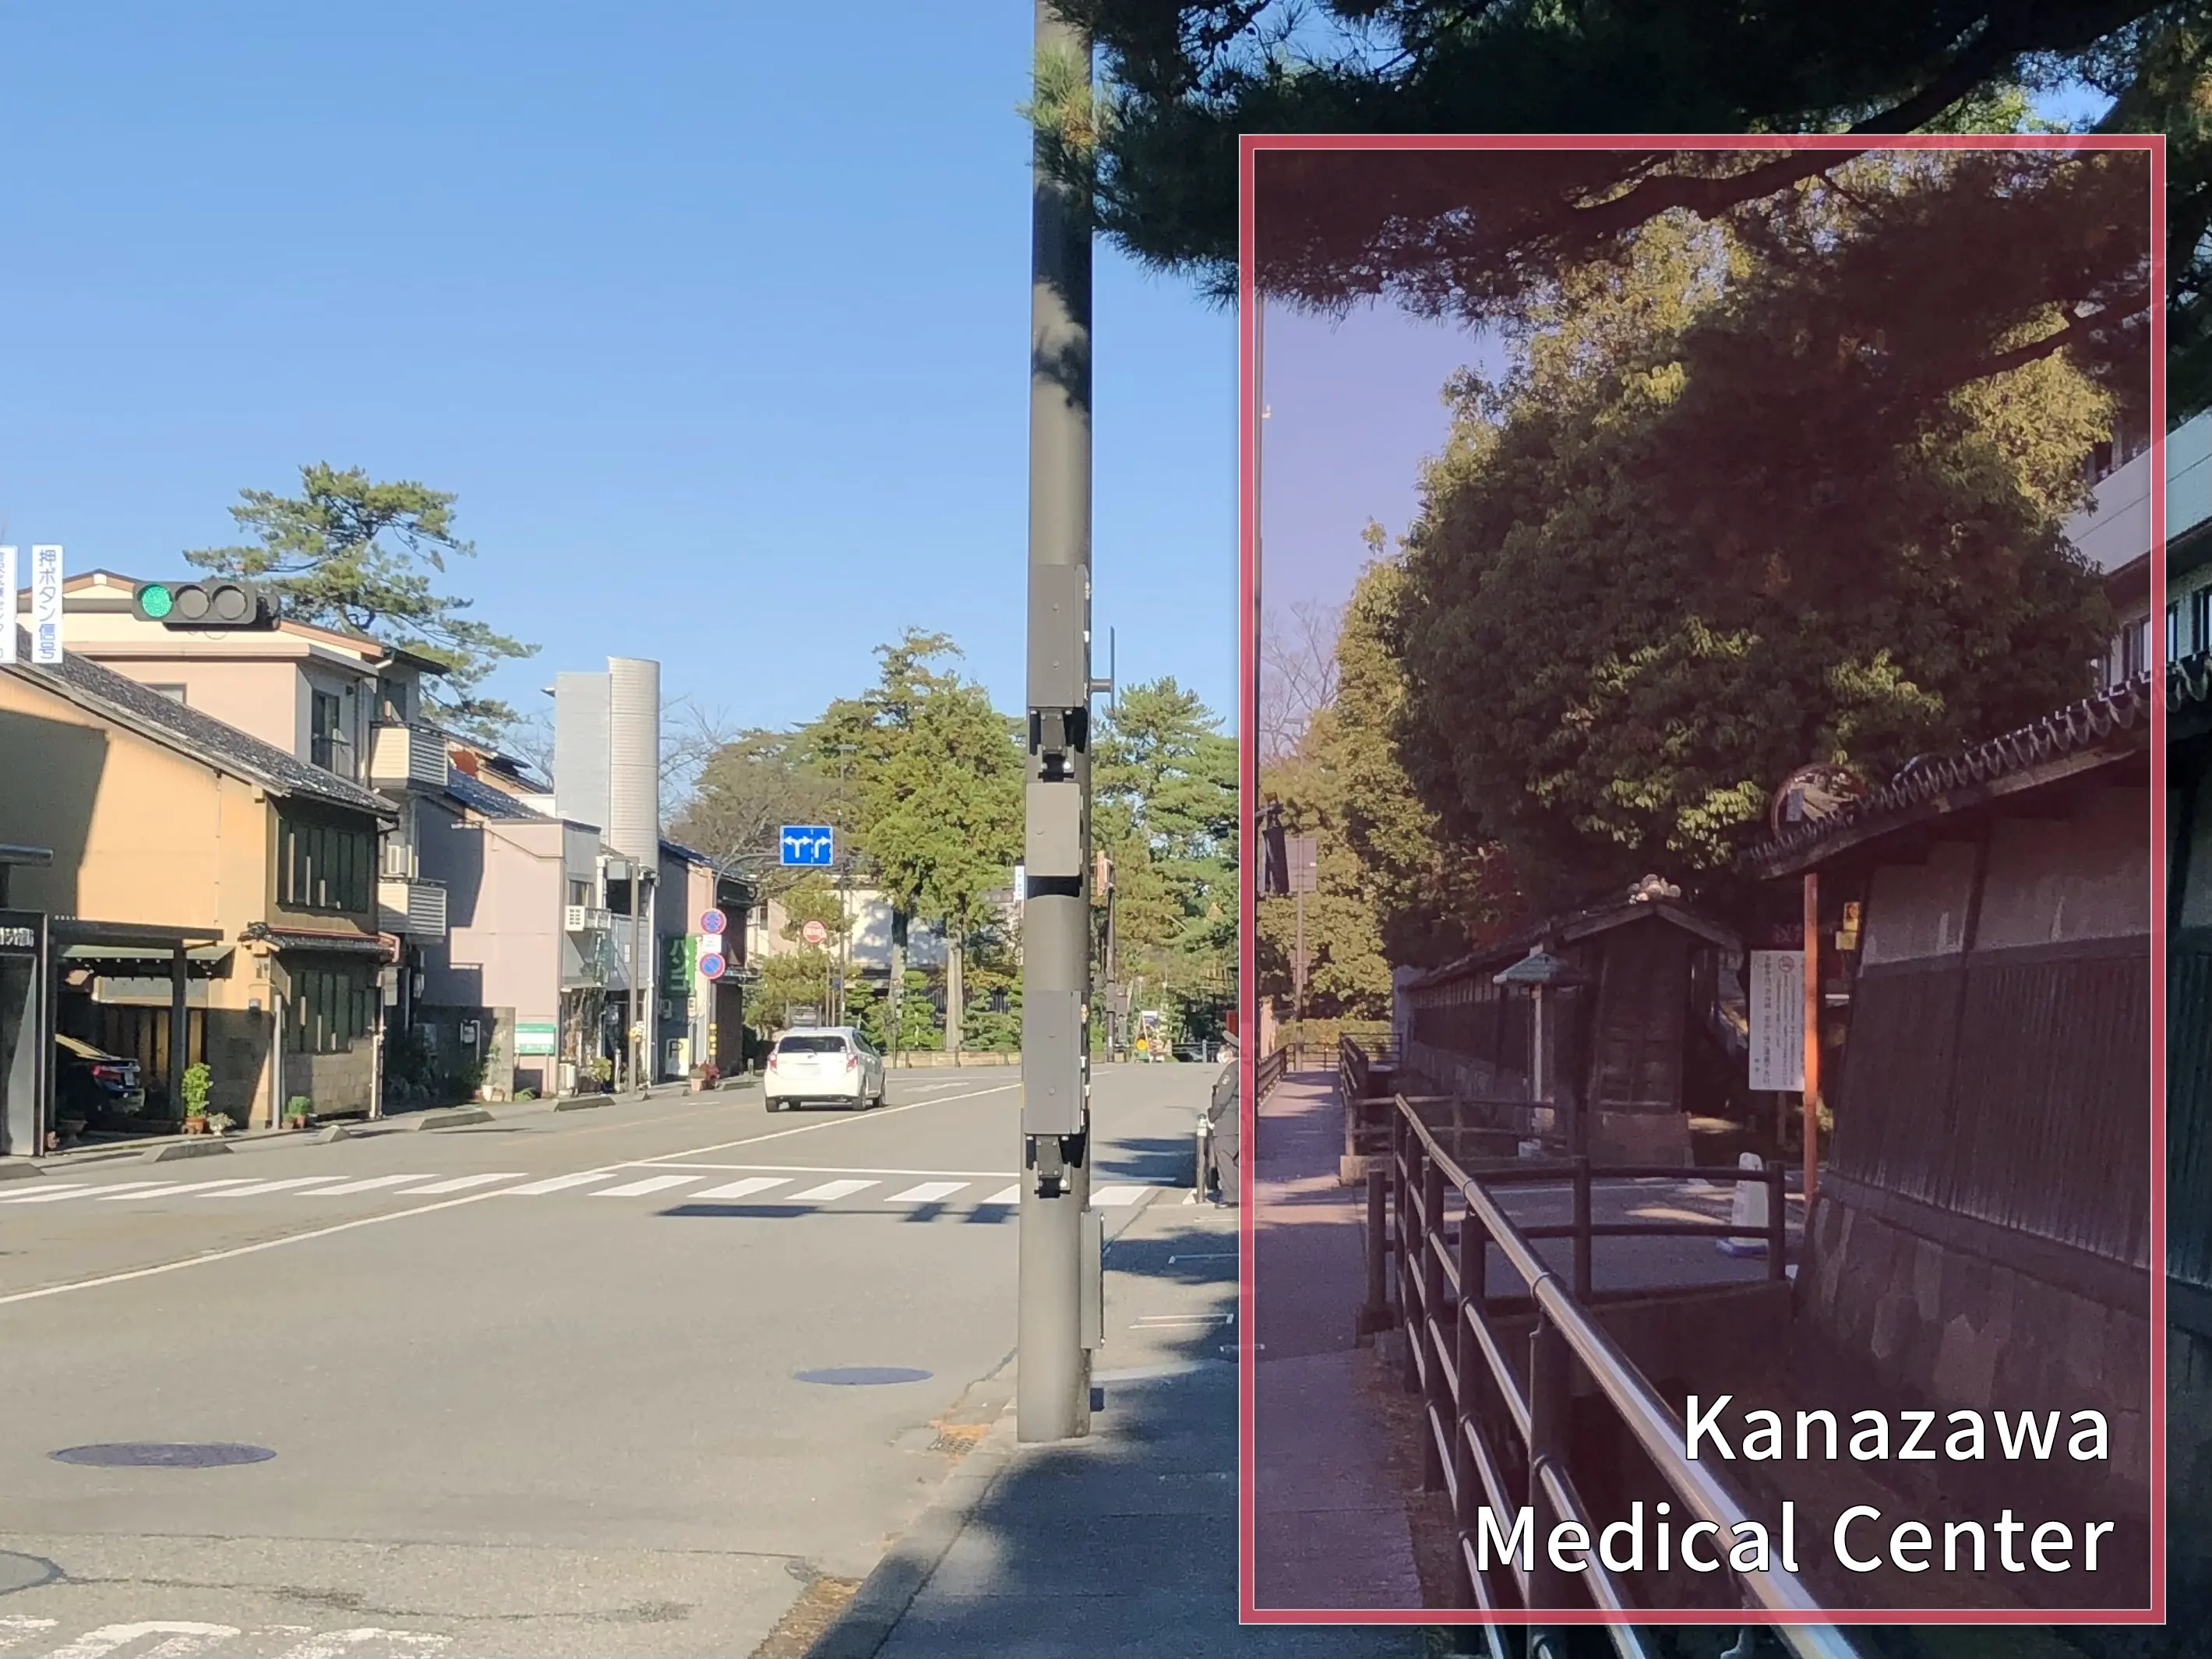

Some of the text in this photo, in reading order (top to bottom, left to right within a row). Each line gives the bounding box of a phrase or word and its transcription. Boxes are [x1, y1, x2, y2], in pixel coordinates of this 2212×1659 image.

[39, 549, 56, 659] 押ボタン信号
[669, 939, 689, 991] ハンコ
[669, 1040, 683, 1058] P
